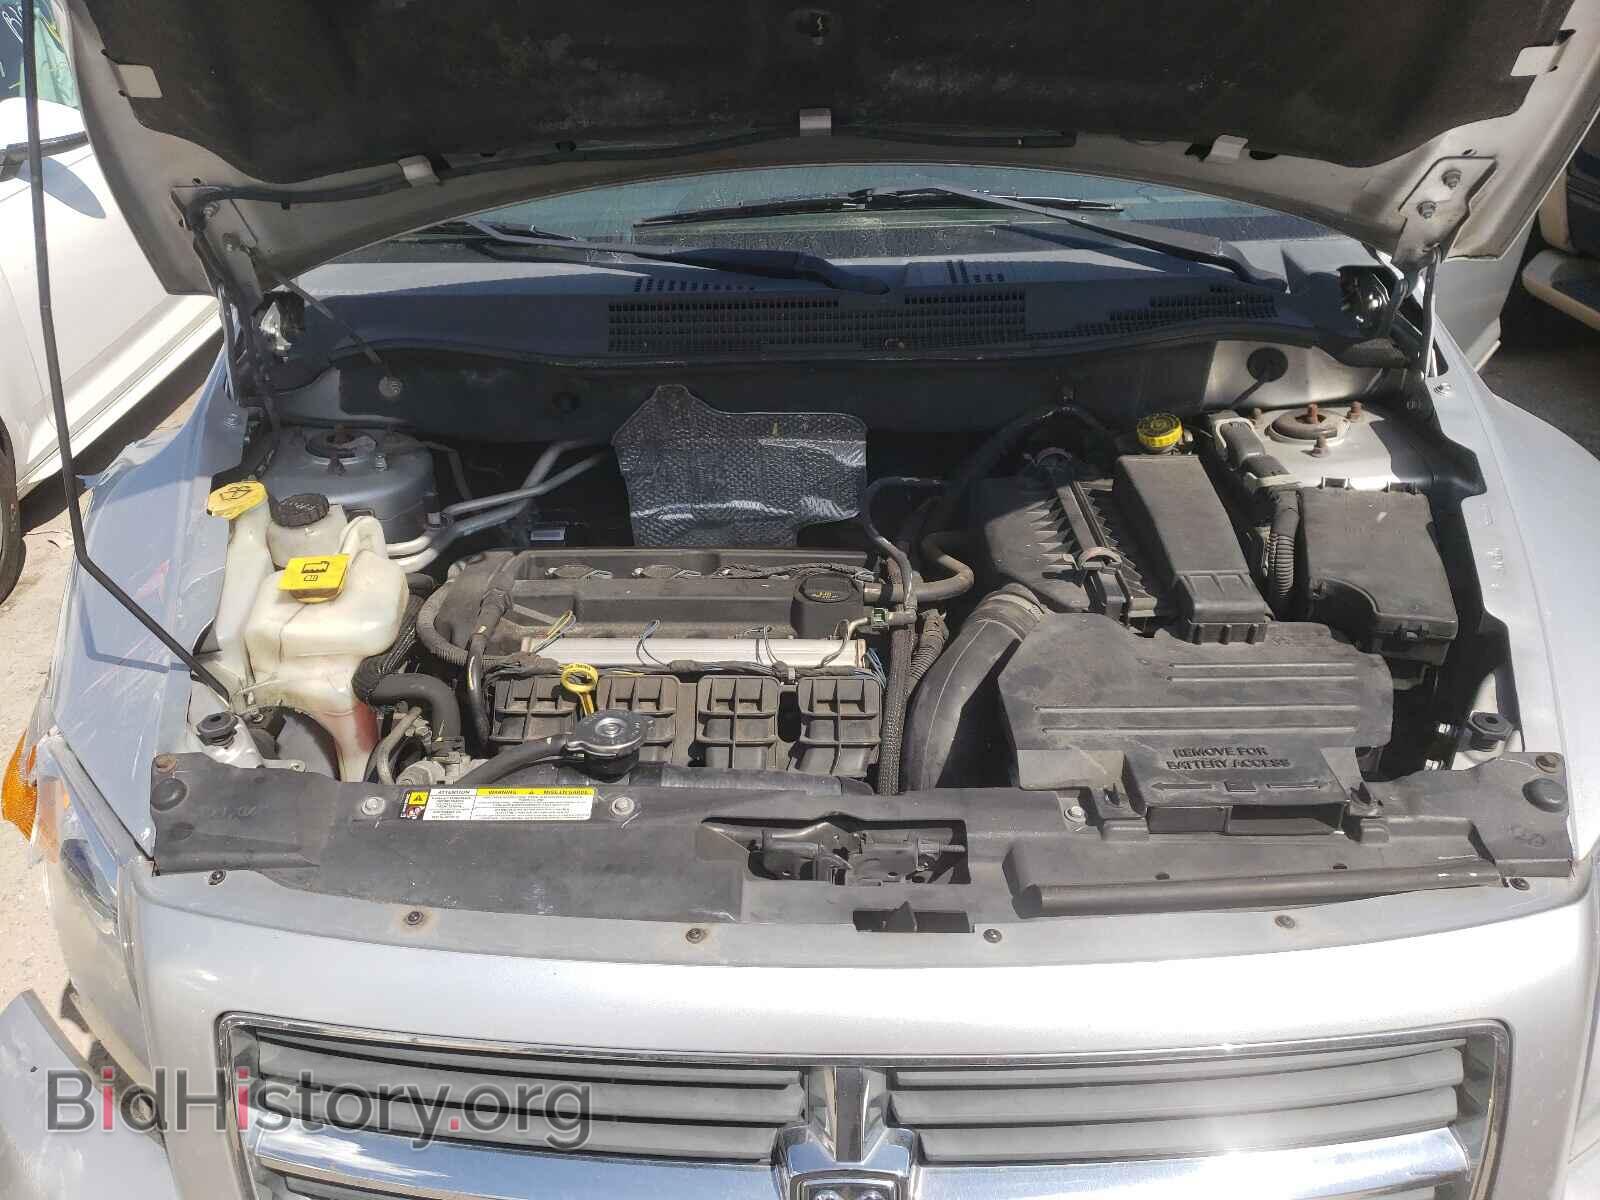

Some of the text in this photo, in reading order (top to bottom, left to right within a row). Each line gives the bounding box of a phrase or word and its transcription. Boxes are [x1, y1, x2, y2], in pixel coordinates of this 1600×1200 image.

[1172, 746, 1269, 758] REMOVE FOR
[1165, 758, 1291, 770] BATTERY ACCESS
